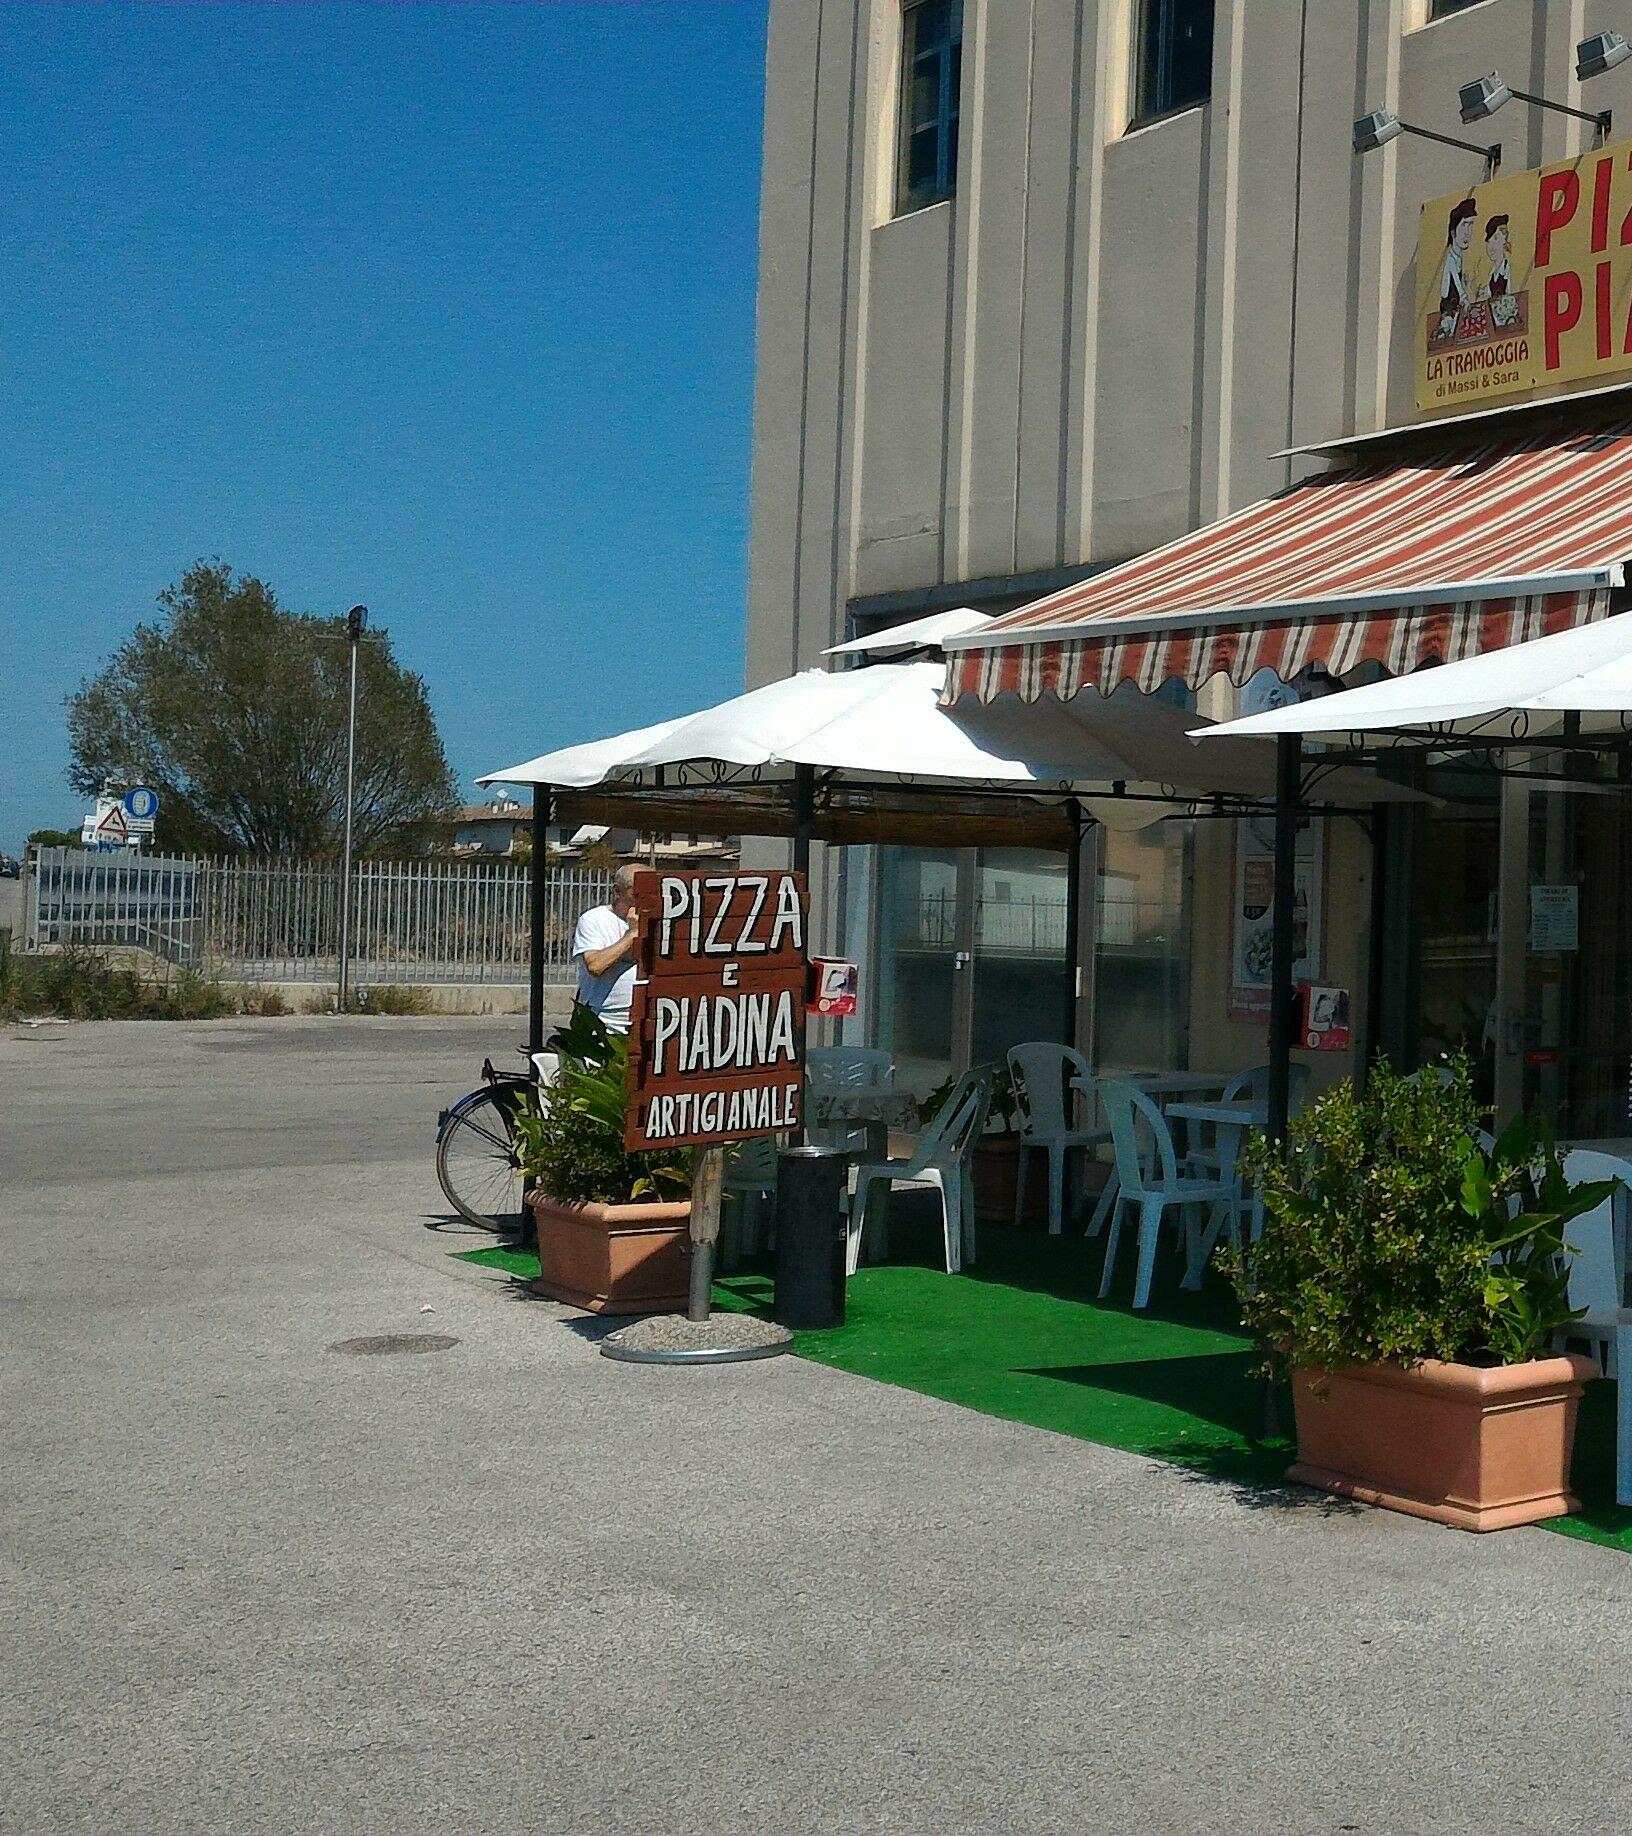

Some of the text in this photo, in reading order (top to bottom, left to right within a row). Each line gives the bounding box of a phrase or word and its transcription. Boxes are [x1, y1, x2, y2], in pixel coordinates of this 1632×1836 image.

[1427, 340, 1529, 381] LA TRAMOGGIA
[1435, 371, 1519, 398] di Massi & Sara
[660, 876, 803, 955] PIZZA
[722, 963, 739, 986] E
[653, 991, 796, 1075] PIADINA
[645, 1084, 798, 1138] ARTIGIANALE
